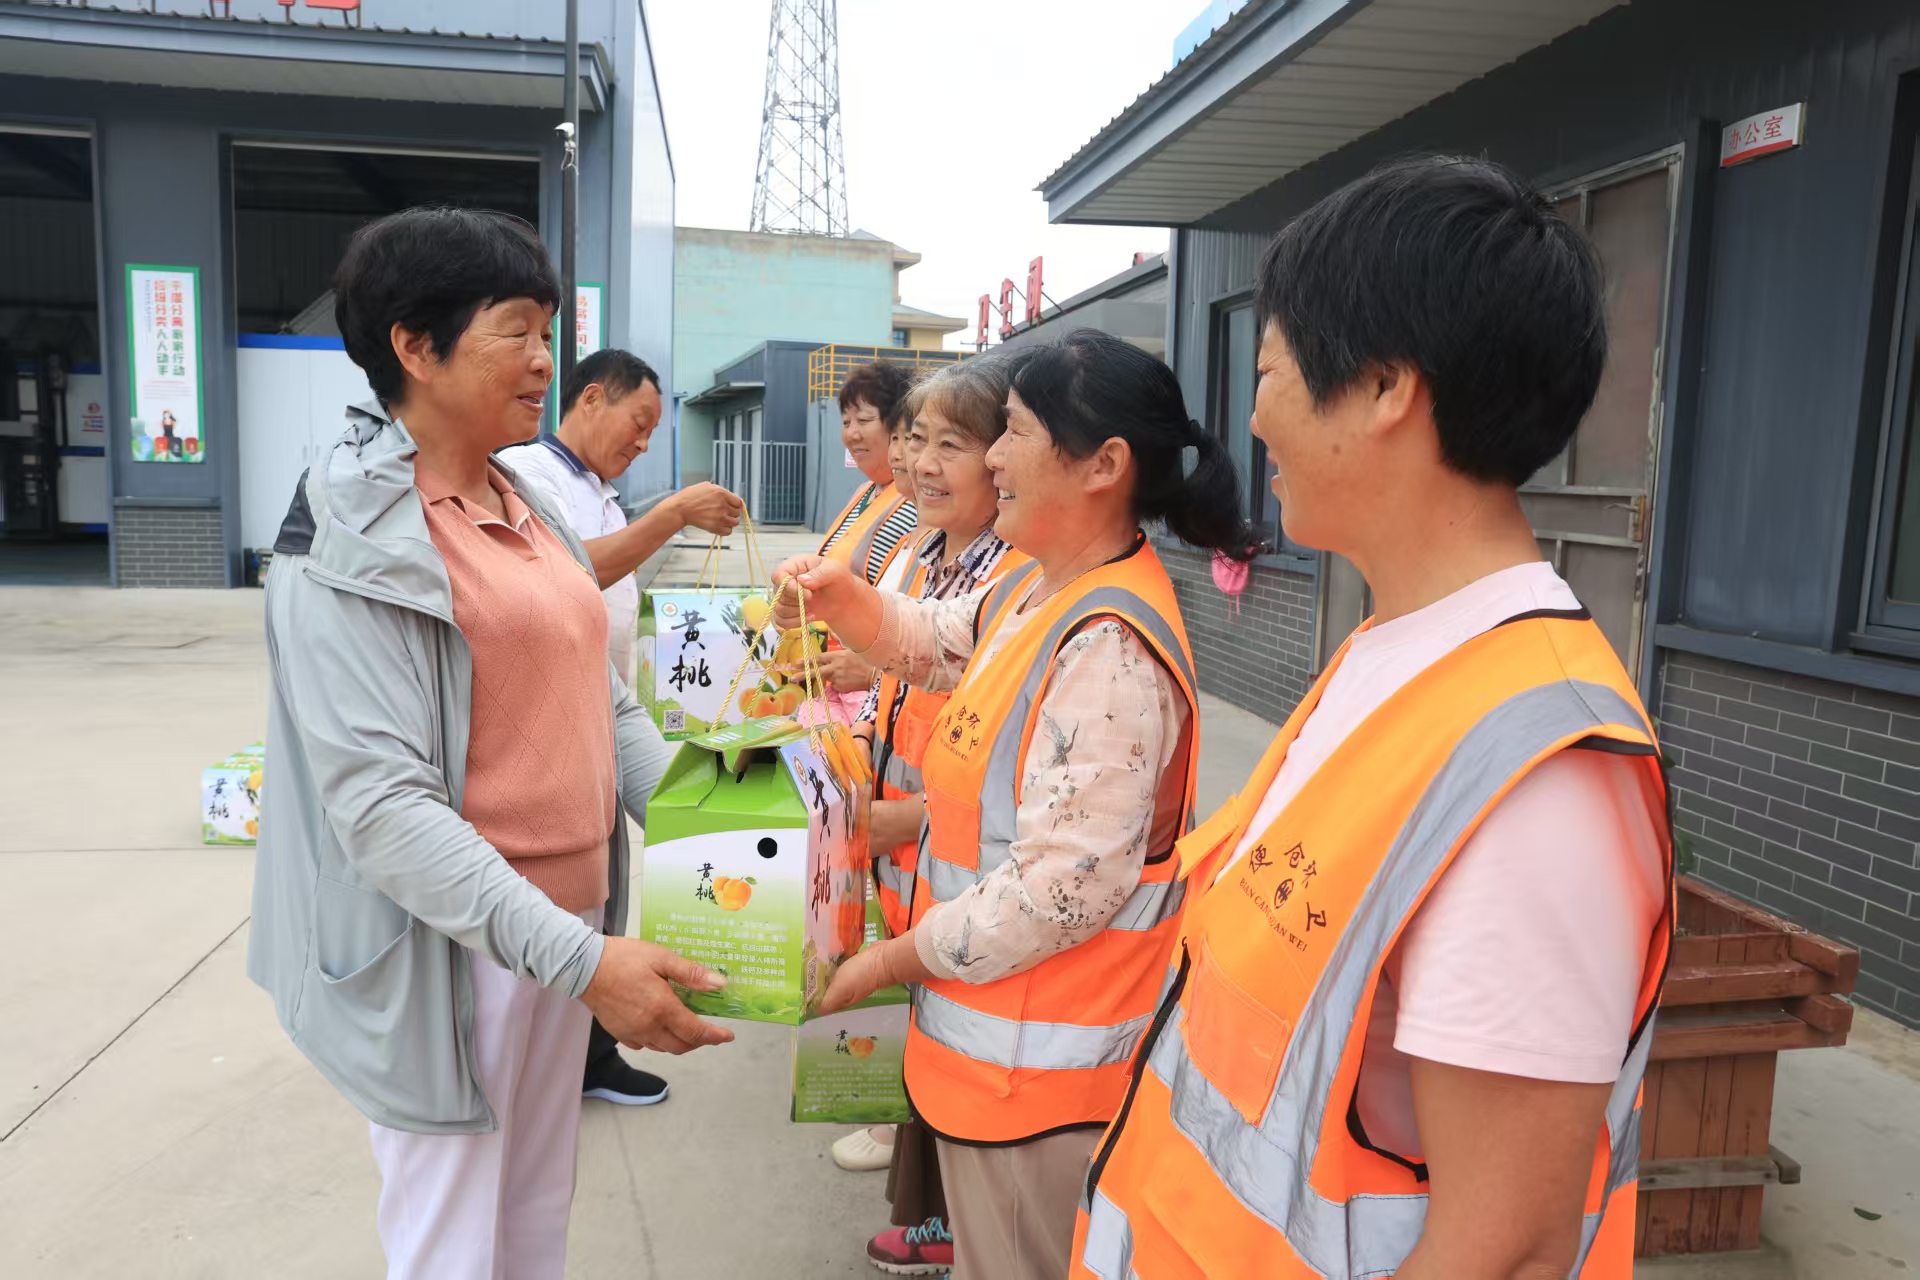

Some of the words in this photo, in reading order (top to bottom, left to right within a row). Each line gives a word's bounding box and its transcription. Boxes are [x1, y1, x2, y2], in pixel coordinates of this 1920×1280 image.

[1728, 116, 1784, 150] 办公室
[154, 280, 169, 376] 垃圾分类人人动手
[669, 610, 712, 693] 黄桃
[208, 777, 229, 820] 黄桃
[807, 766, 831, 923] 黄桃
[695, 862, 715, 901] 黄桃
[1239, 877, 1256, 899] BIAN
[1289, 932, 1308, 952] WEI
[834, 1029, 851, 1055] 黄桃
